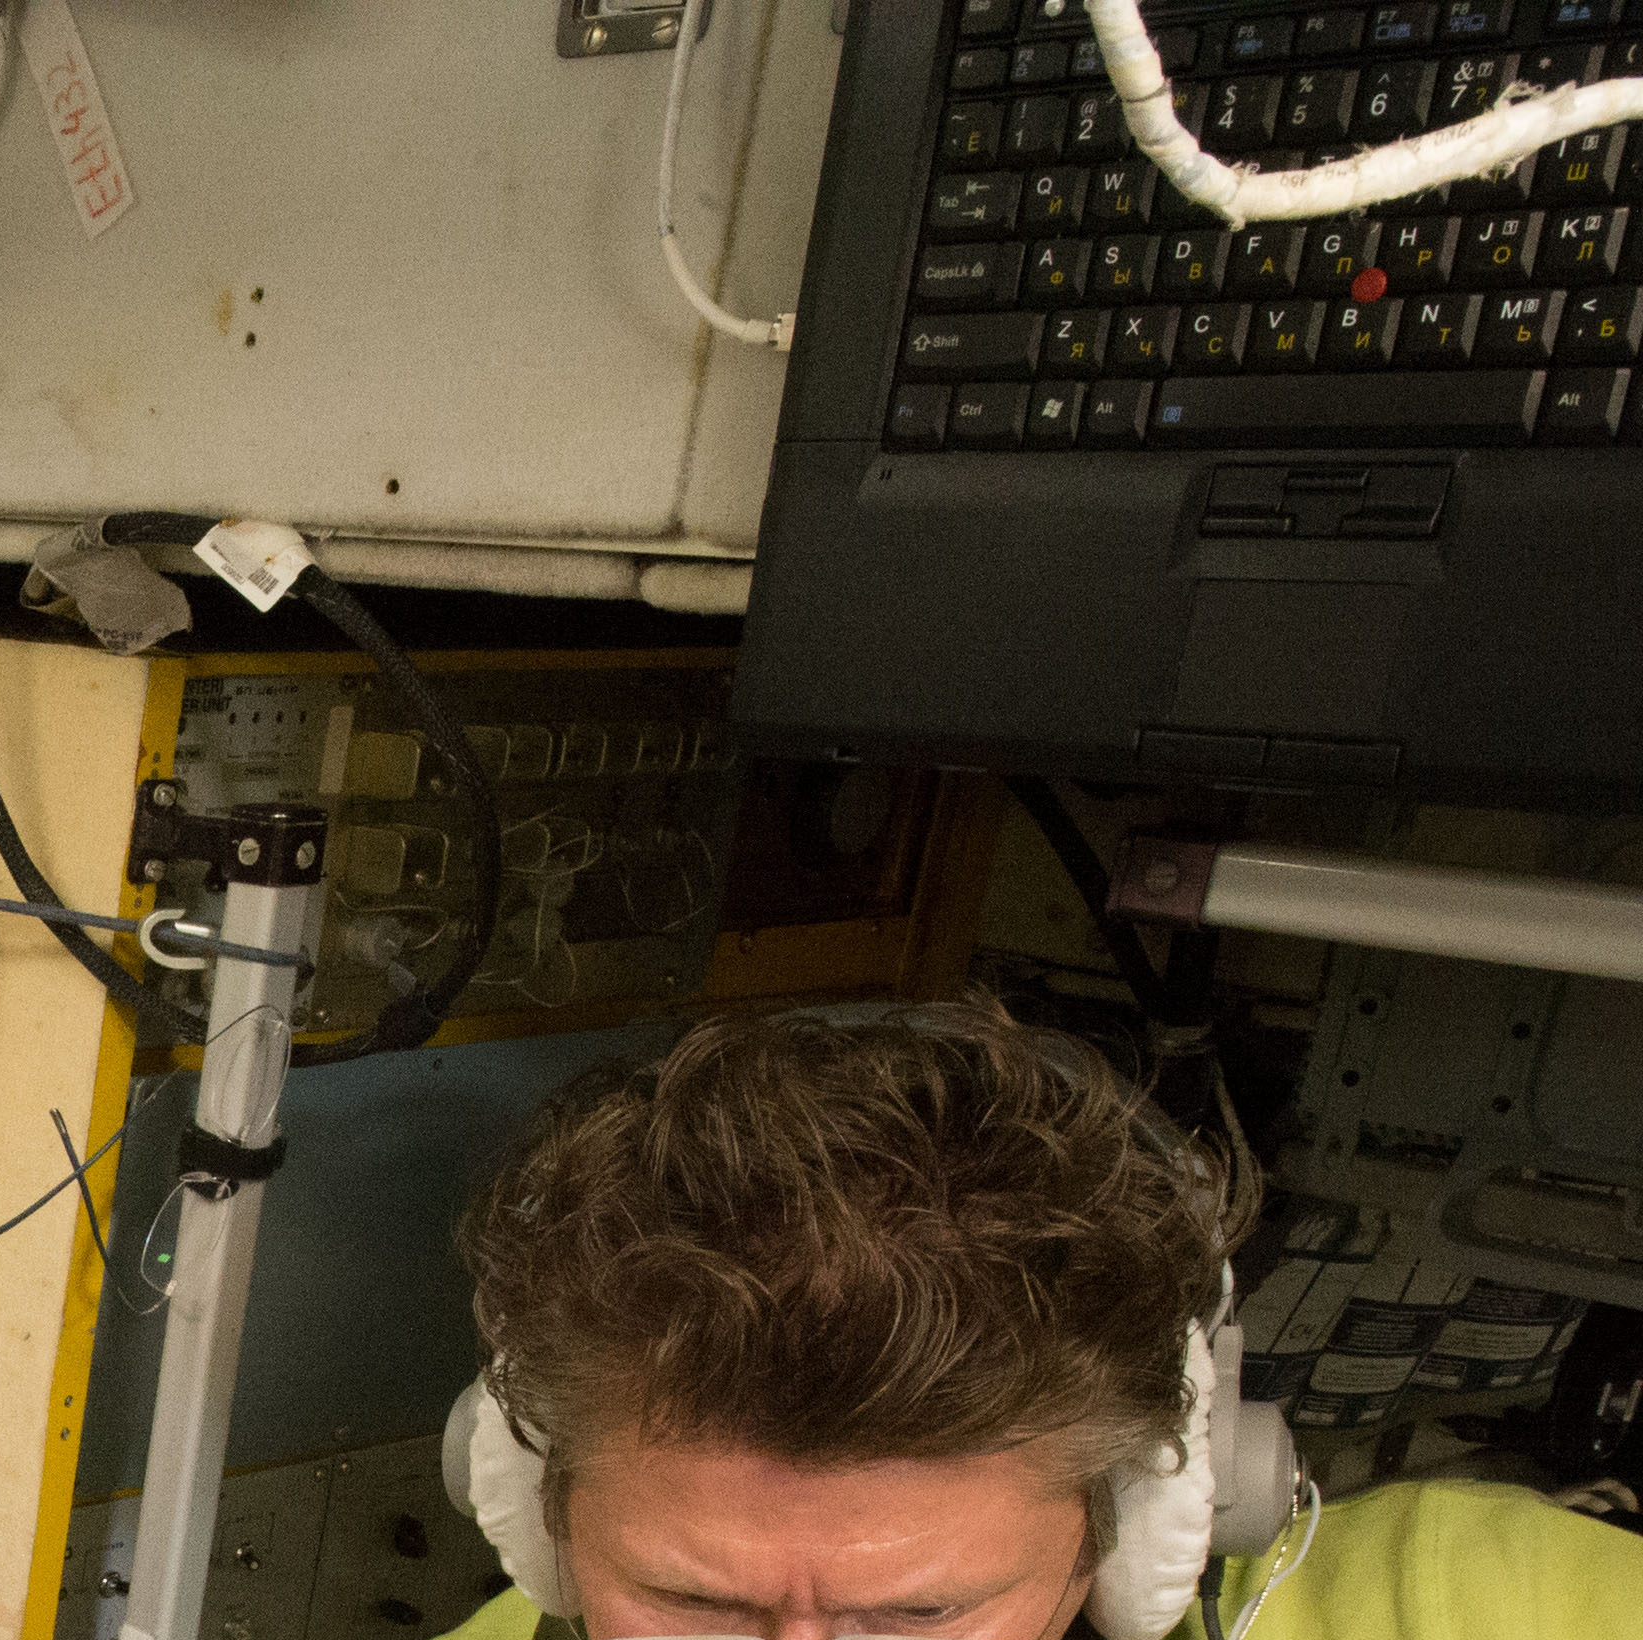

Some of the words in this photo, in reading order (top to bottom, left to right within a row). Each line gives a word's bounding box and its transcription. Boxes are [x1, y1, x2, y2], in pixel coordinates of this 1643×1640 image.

[1371, 93, 1387, 116] 6
[1451, 85, 1467, 109] 7
[1218, 108, 1233, 129] 4
[1293, 105, 1307, 124] 5
[1077, 119, 1093, 140] 2
[1037, 177, 1052, 195] Q
[1104, 172, 1125, 191] W
[1399, 228, 1416, 246] H
[1480, 222, 1494, 241] J
[1561, 219, 1580, 238] K
[1175, 241, 1191, 258] D
[1247, 237, 1262, 254] F
[1324, 235, 1341, 252] G
[1039, 250, 1054, 266] A
[1105, 247, 1119, 264] S
[1341, 309, 1358, 326] B
[1421, 305, 1440, 322] N
[1500, 301, 1523, 319] M
[1126, 318, 1142, 335] X
[1194, 316, 1210, 332] C
[1269, 312, 1284, 329] V
[1057, 321, 1073, 338] Z
[933, 336, 959, 348] Shift
[1559, 393, 1580, 406] Alt
[960, 404, 983, 416] Ctrl
